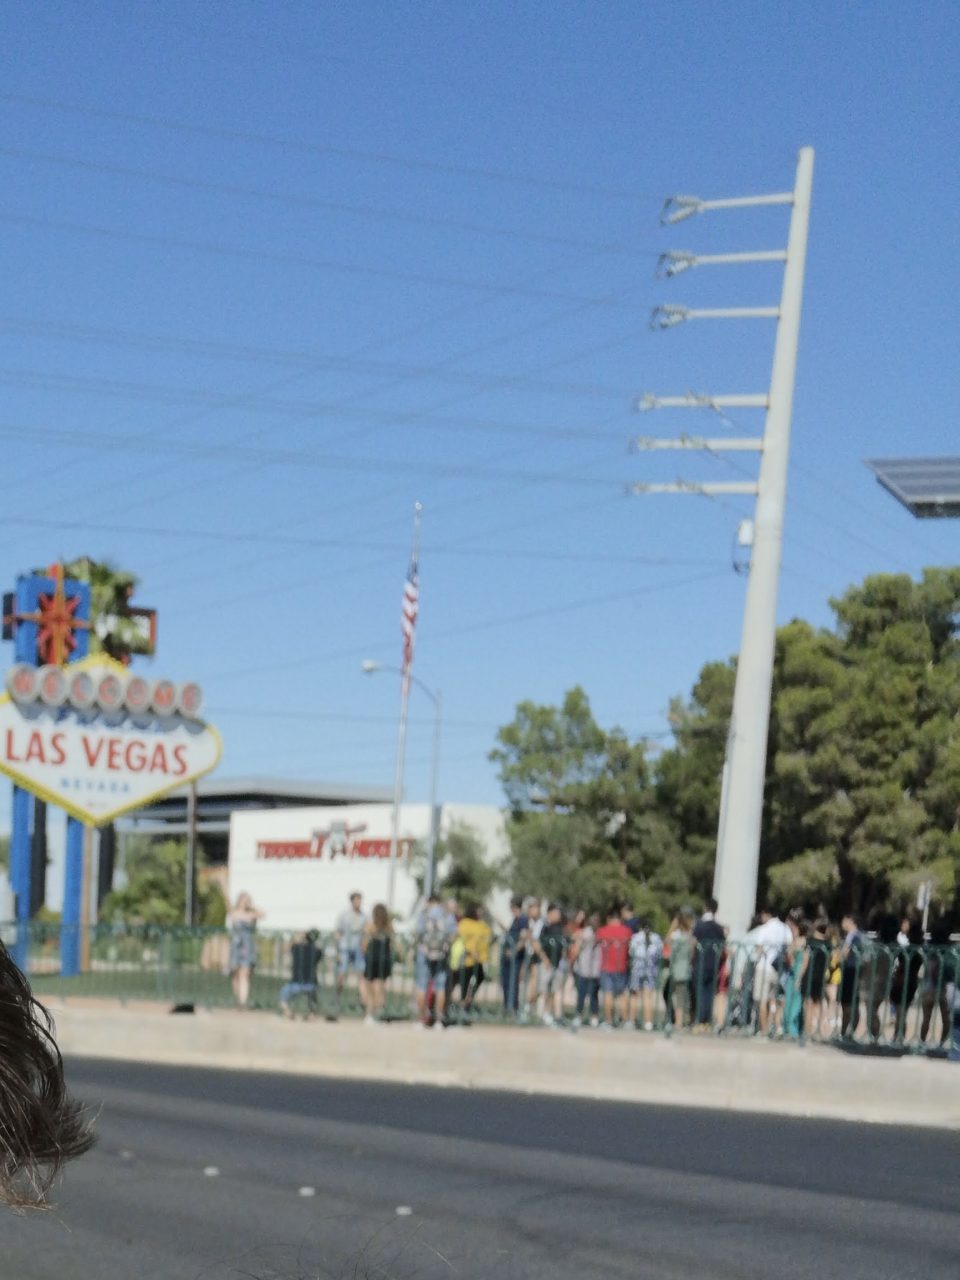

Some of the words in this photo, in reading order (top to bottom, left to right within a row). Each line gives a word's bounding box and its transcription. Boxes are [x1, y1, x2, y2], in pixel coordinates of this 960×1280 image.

[13, 669, 201, 713] WELCOME
[5, 728, 67, 766] LAS
[82, 735, 188, 777] VEGAS
[59, 776, 131, 793] NEVADA
